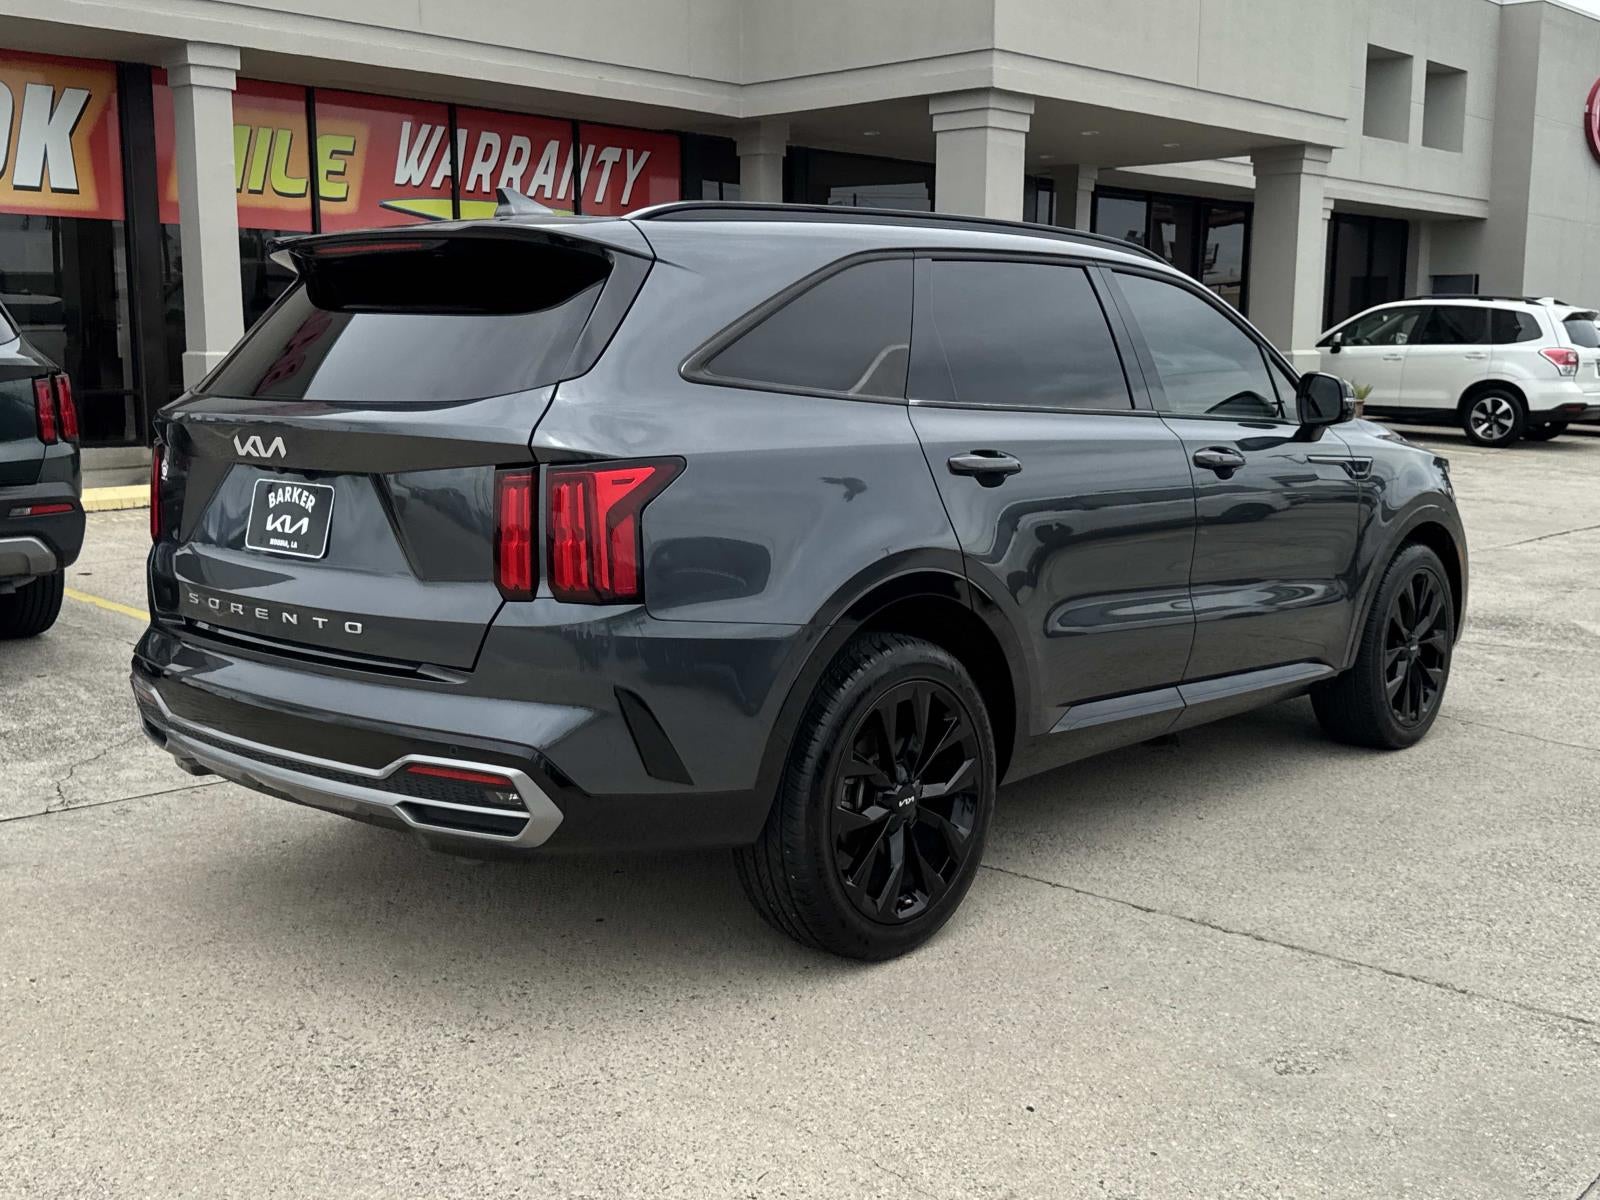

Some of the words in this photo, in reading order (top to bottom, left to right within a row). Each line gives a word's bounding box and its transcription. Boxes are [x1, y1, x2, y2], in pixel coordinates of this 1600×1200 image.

[394, 121, 651, 207] WARRANTY
[233, 434, 287, 458] KIA
[268, 486, 316, 513] BARKER
[265, 513, 309, 535] KIA
[188, 592, 363, 634] SORENTO
